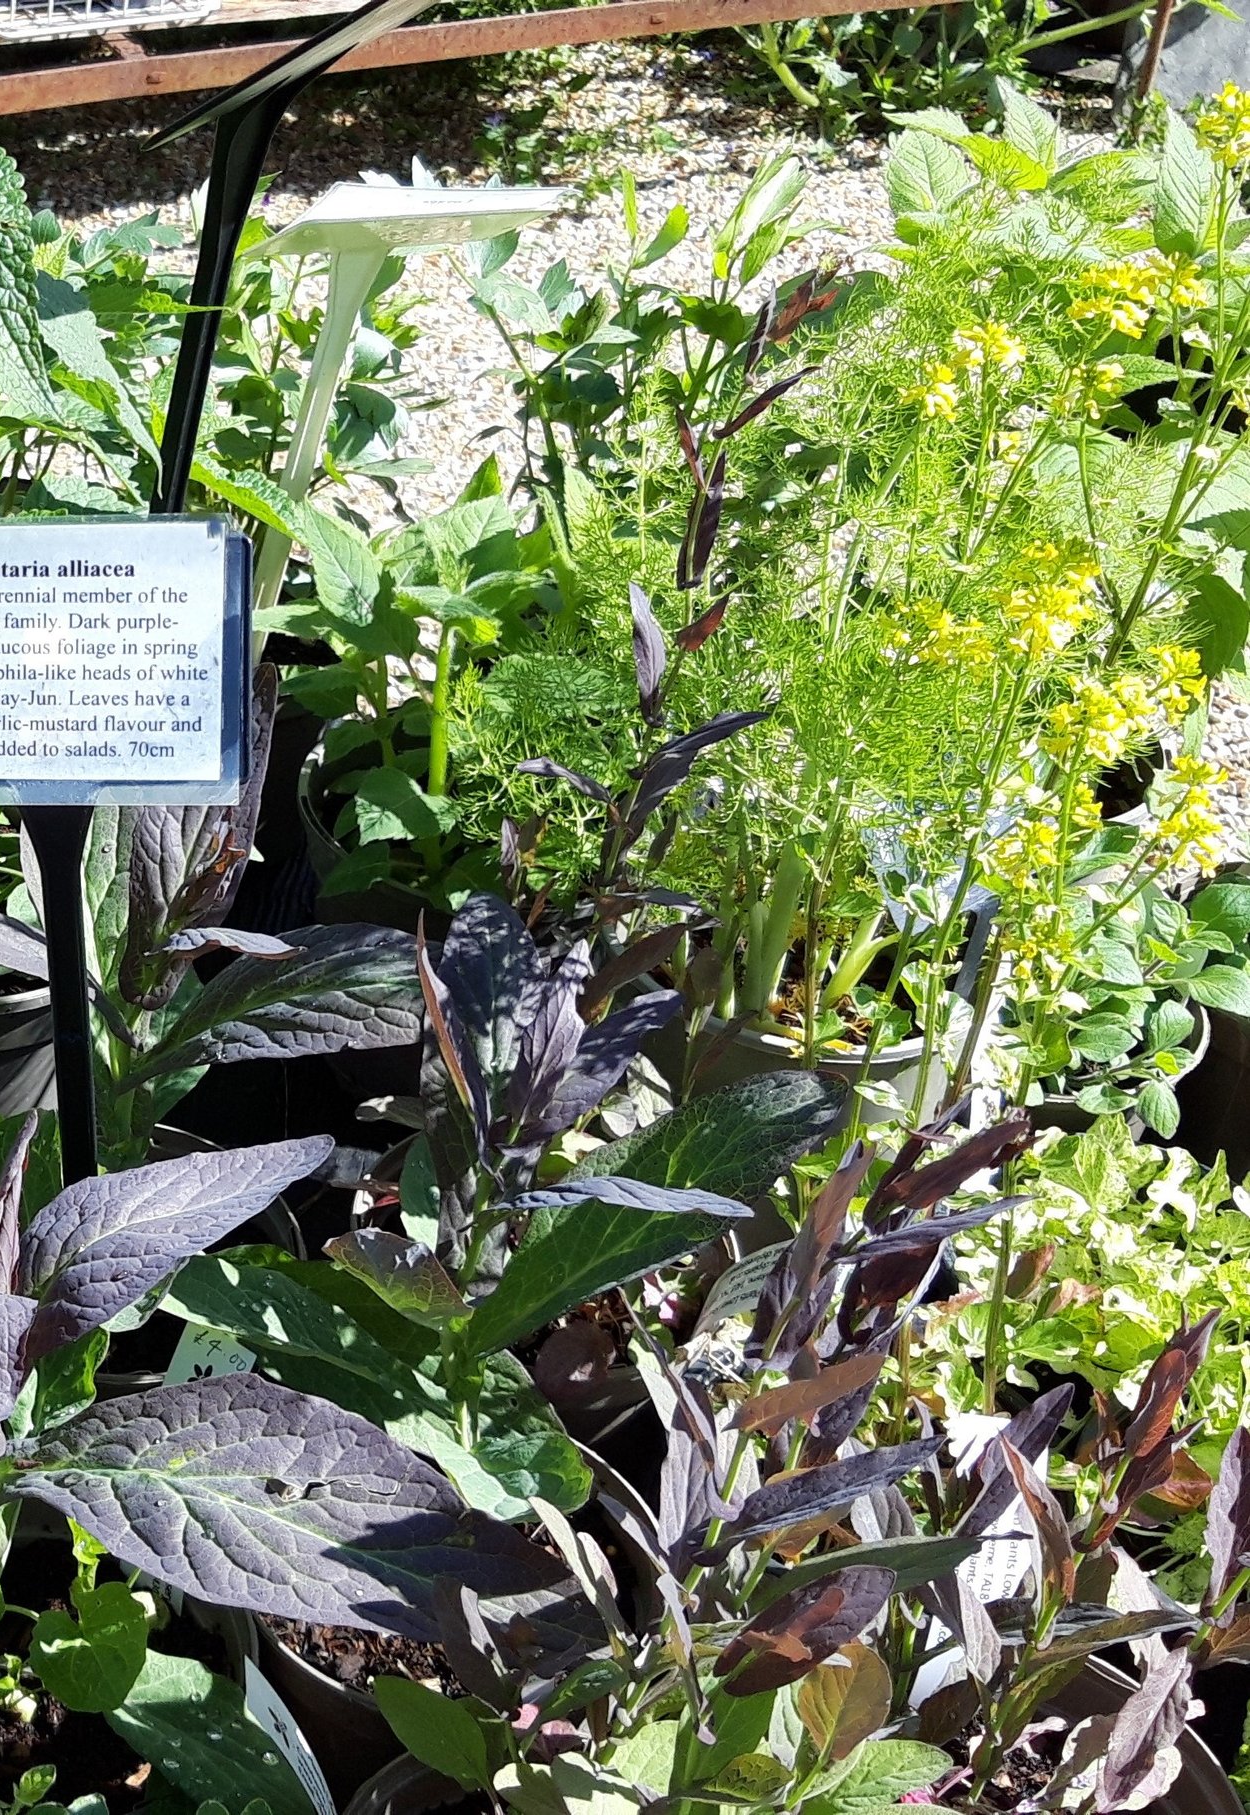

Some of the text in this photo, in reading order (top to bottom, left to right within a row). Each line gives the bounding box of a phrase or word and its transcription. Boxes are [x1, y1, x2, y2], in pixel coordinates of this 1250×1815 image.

[56, 559, 136, 579] alliacea
[62, 587, 134, 604] member
[137, 586, 159, 604] of
[161, 587, 188, 604] the
[4, 611, 63, 634] family.
[68, 612, 111, 630] Dark
[116, 612, 180, 634] purple-
[57, 637, 116, 660] foliage
[122, 638, 138, 655] in
[143, 638, 199, 660] spring
[82, 663, 132, 681] heads
[136, 662, 158, 681] of
[160, 663, 209, 681] white
[68, 689, 129, 707] Leaves
[134, 690, 176, 707] have
[180, 695, 191, 707] a
[103, 715, 165, 733] flavour
[170, 715, 203, 733] and
[41, 742, 60, 757] to
[64, 739, 123, 758] salads.
[128, 740, 176, 758] 70cm
